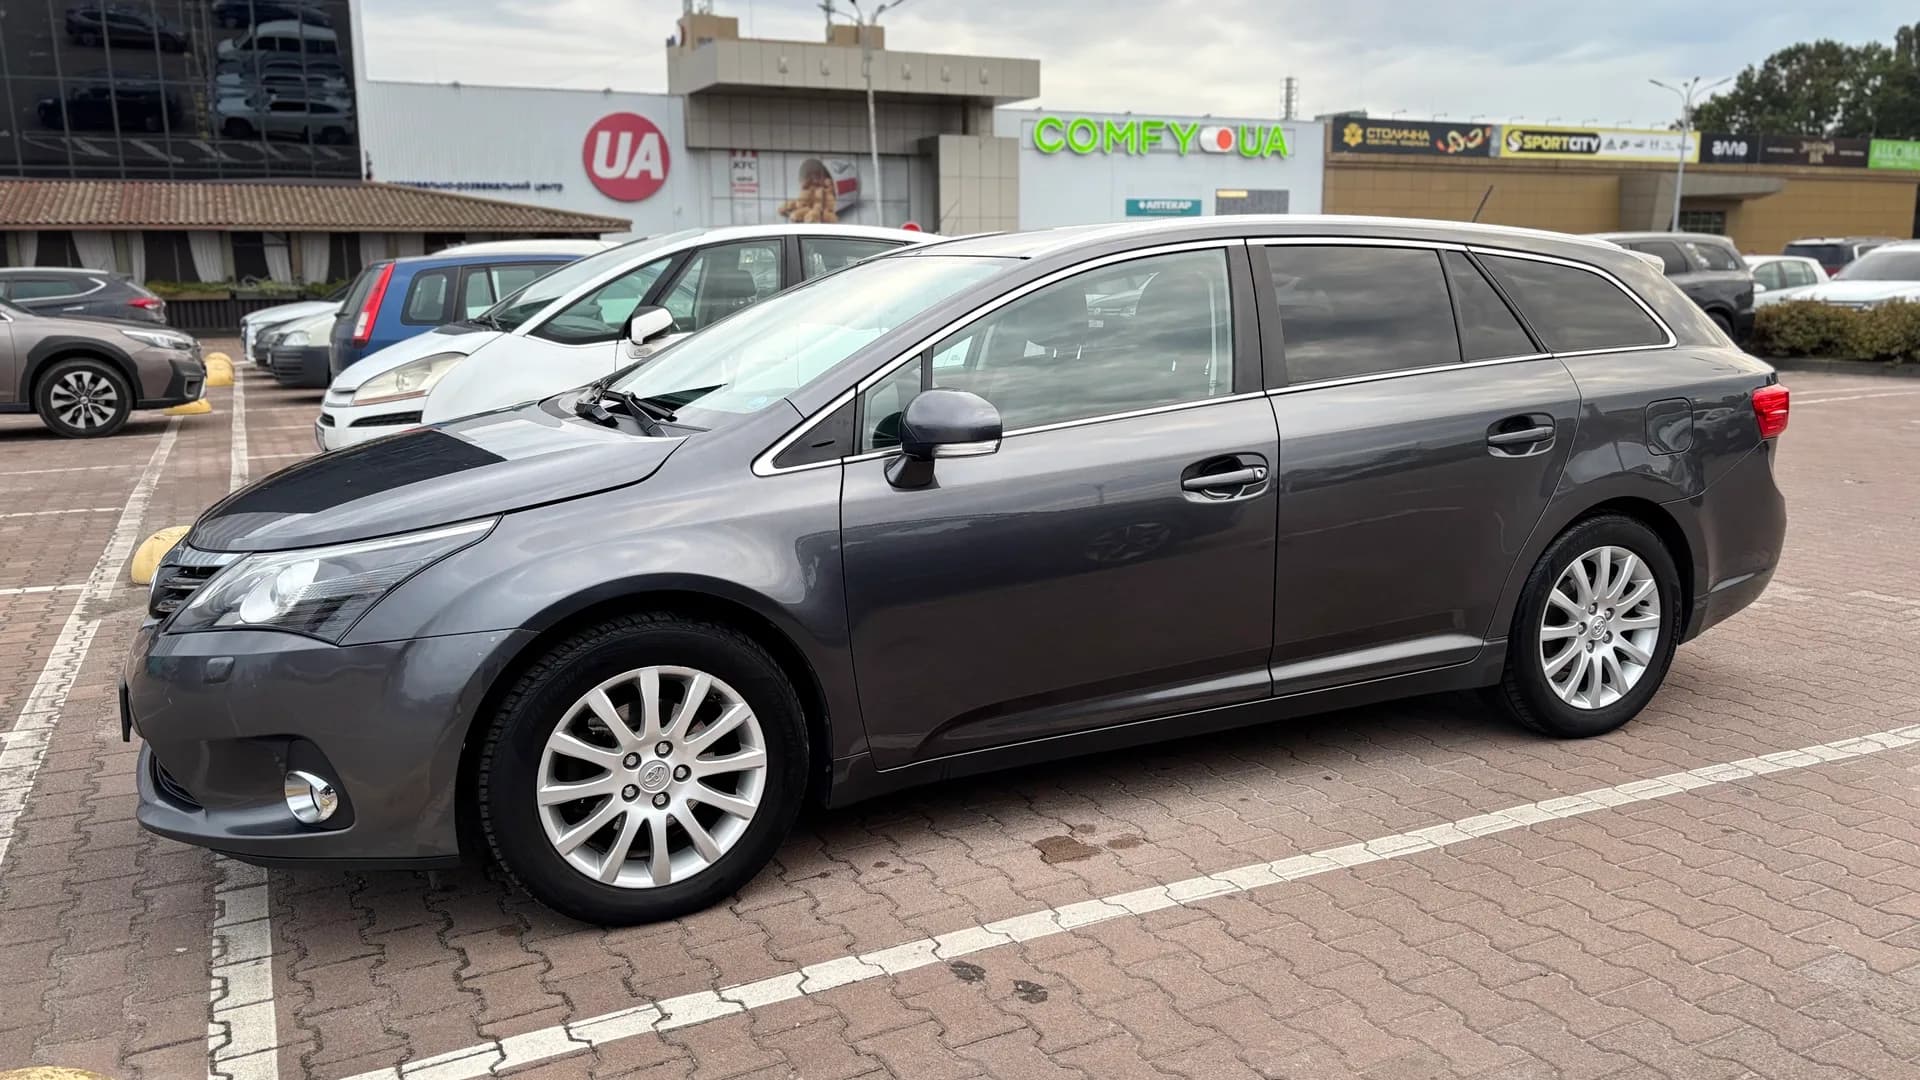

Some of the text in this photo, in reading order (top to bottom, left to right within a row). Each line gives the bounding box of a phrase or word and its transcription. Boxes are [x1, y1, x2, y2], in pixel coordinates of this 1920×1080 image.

[1033, 116, 1289, 158] COMFY UA
[1523, 134, 1599, 151] SPORTCITY
[592, 131, 663, 180] UA
[733, 160, 756, 169] KFC
